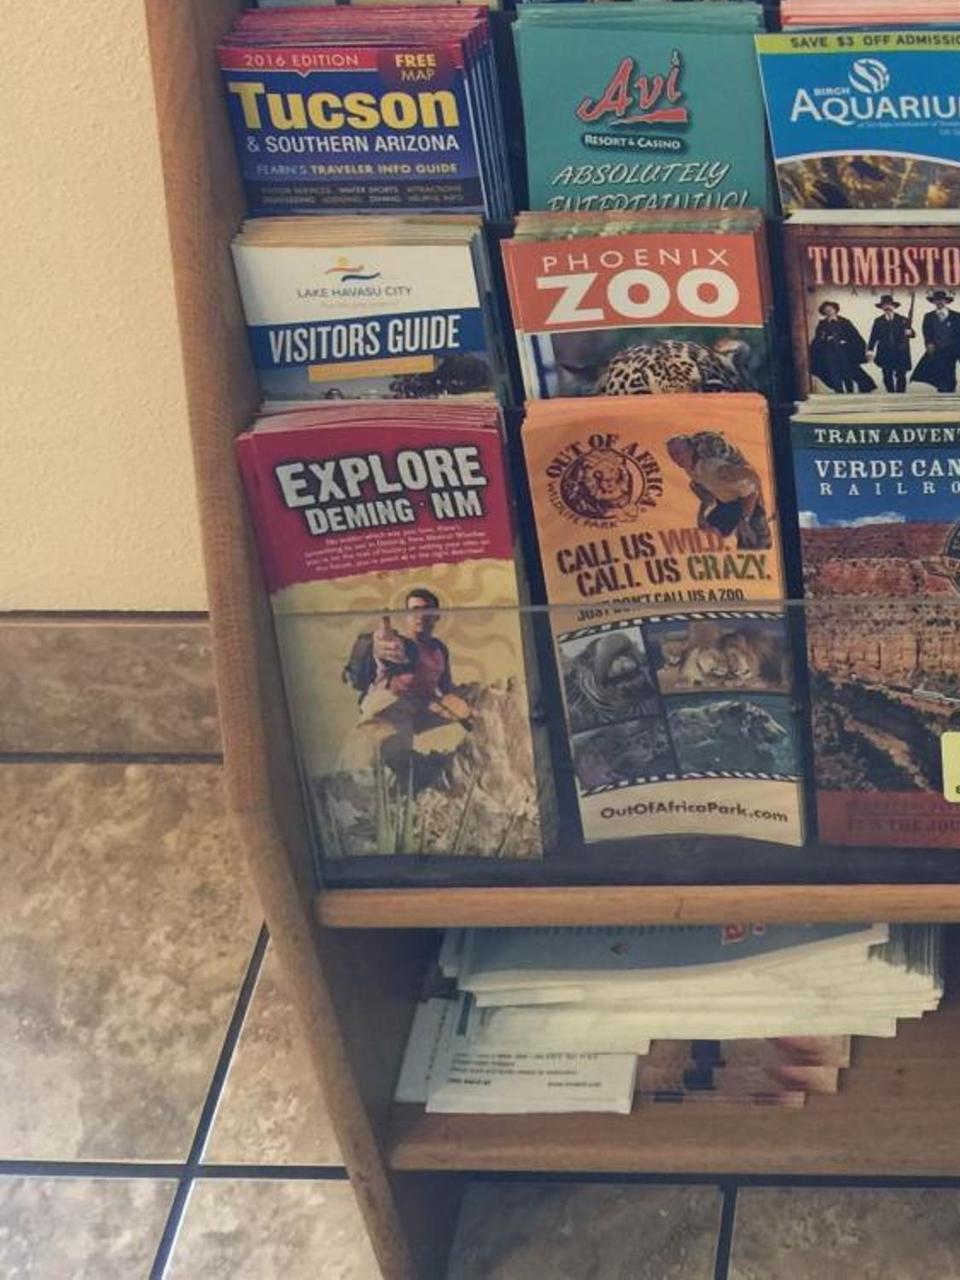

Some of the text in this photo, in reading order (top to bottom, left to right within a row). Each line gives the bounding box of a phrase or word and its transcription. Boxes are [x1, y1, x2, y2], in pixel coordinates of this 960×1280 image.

[790, 36, 828, 49] SAVE
[862, 34, 892, 47] OFF
[245, 52, 360, 68] 2016 EDITION
[395, 53, 437, 67] FREE
[229, 81, 461, 130] Tucson
[265, 133, 461, 154] SOUTHERN ARIZONA
[584, 133, 682, 150] RESORT CASINO
[311, 162, 458, 176] TRAVELER INFO GUIDE
[552, 161, 731, 189] ABSOLUTELY
[542, 248, 730, 273] PHOENIX
[297, 286, 382, 299] LAKE HAVASU
[536, 268, 740, 325] ZOO
[269, 314, 461, 364] VISITORS GUIDE
[814, 427, 882, 445] TRAIN
[276, 446, 488, 509] EXPLORE
[814, 458, 904, 480] VERDE
[305, 488, 483, 536] DEMING NM
[556, 536, 620, 574] CALL
[576, 563, 641, 598] CALL
[600, 801, 788, 823] OutOfAfricaPark.com
